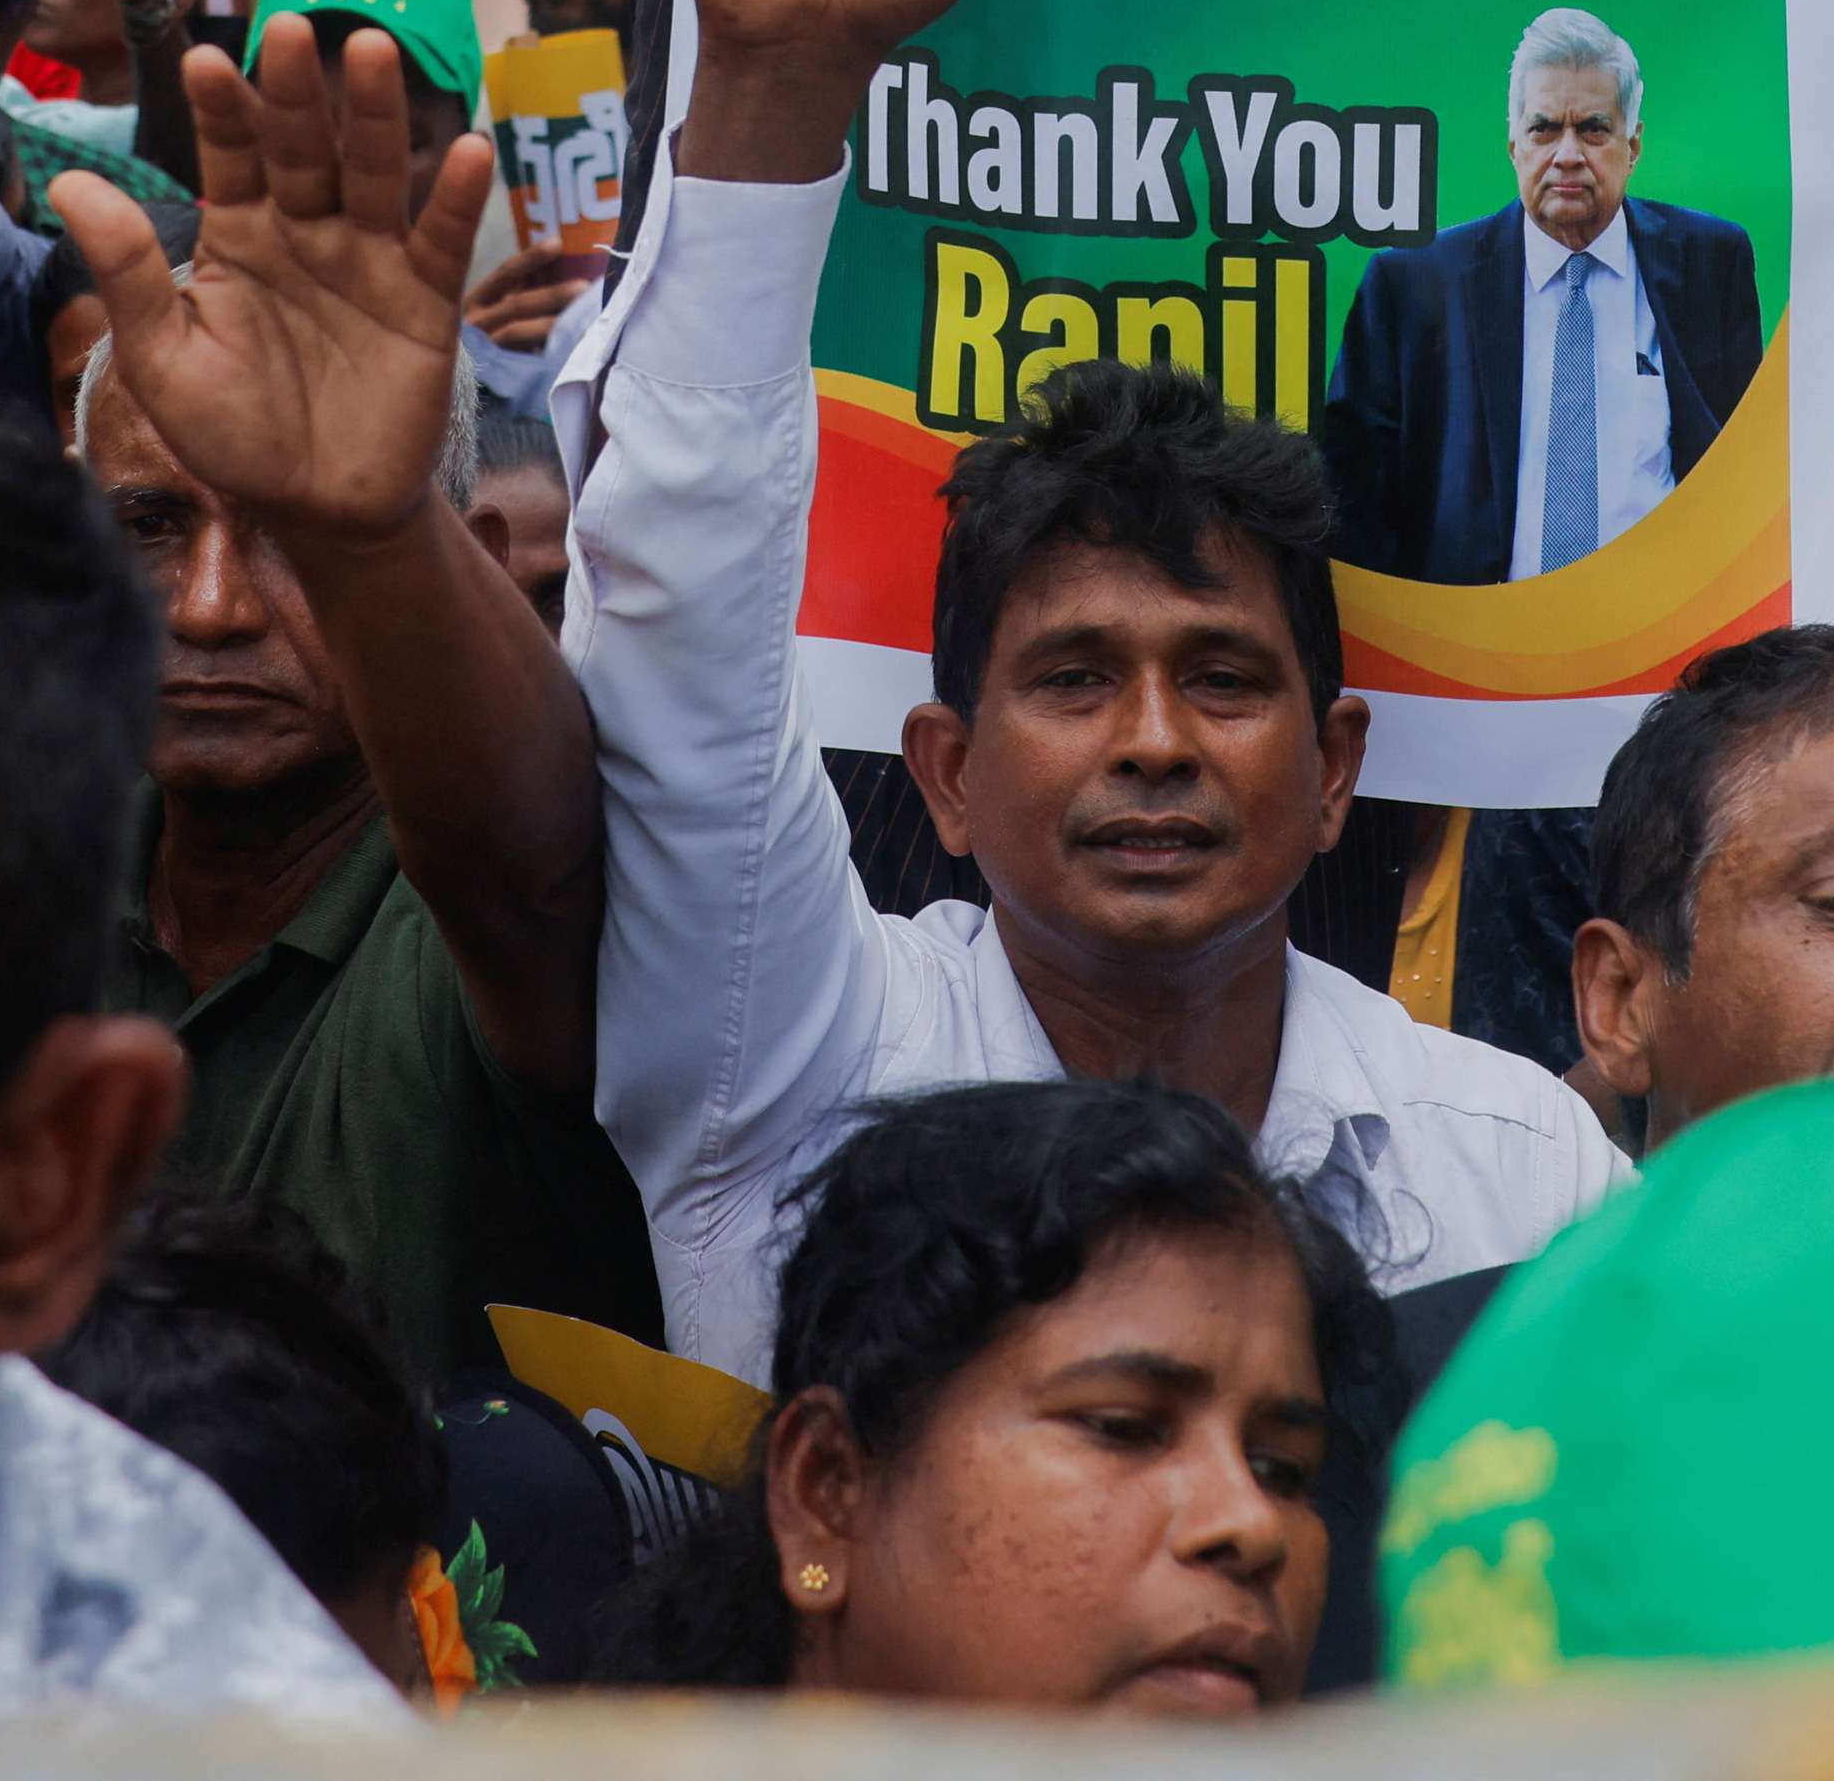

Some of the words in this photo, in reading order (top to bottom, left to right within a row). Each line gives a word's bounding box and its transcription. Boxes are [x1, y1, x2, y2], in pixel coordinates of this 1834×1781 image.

[865, 60, 1183, 220] Thank
[1197, 89, 1421, 232] You
[927, 242, 1311, 435] Ranil
